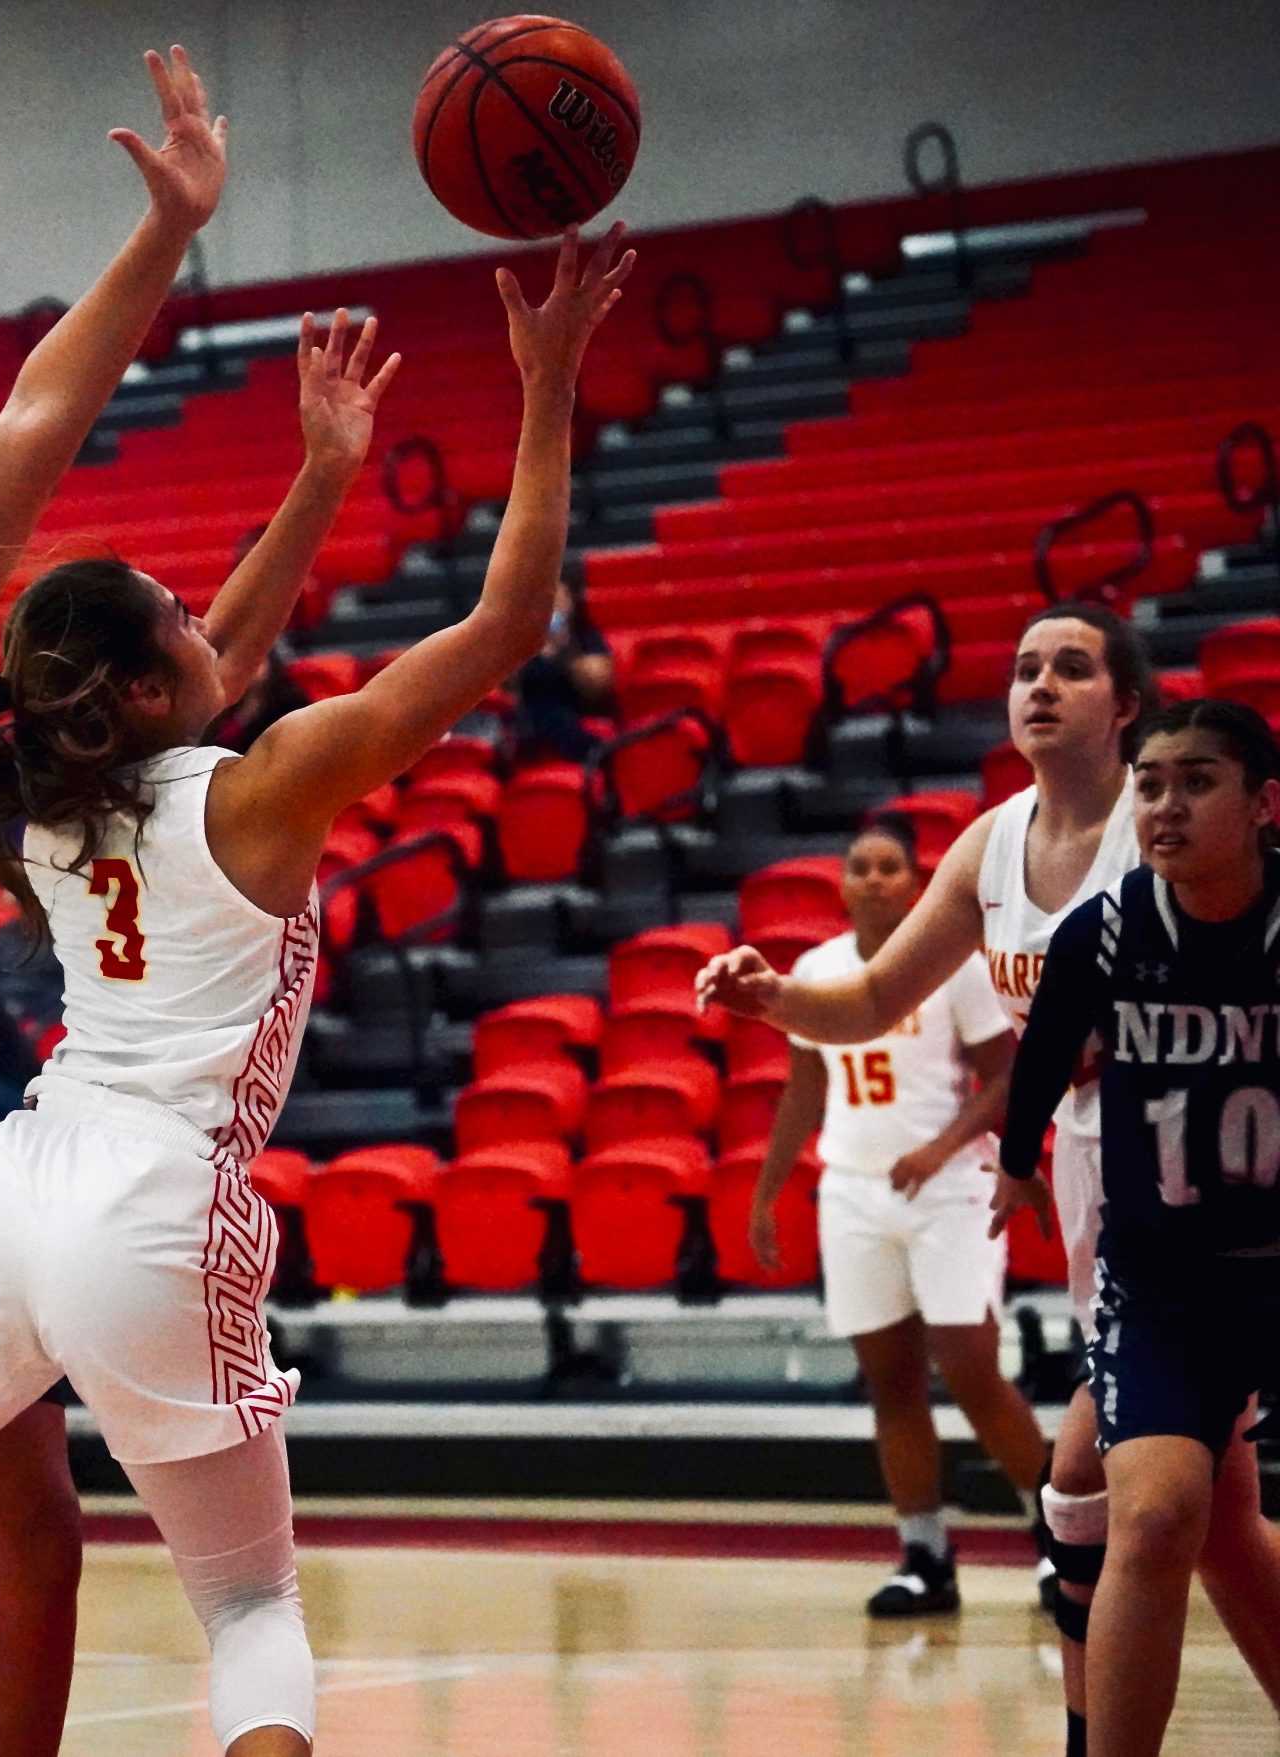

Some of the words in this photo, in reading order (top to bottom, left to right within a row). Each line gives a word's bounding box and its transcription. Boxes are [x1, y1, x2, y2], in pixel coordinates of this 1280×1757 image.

[548, 78, 628, 188] Wilso
[88, 856, 148, 983] 3
[841, 1051, 896, 1106] 15
[1114, 1001, 1280, 1066] NDN
[1144, 1088, 1280, 1207] 10
